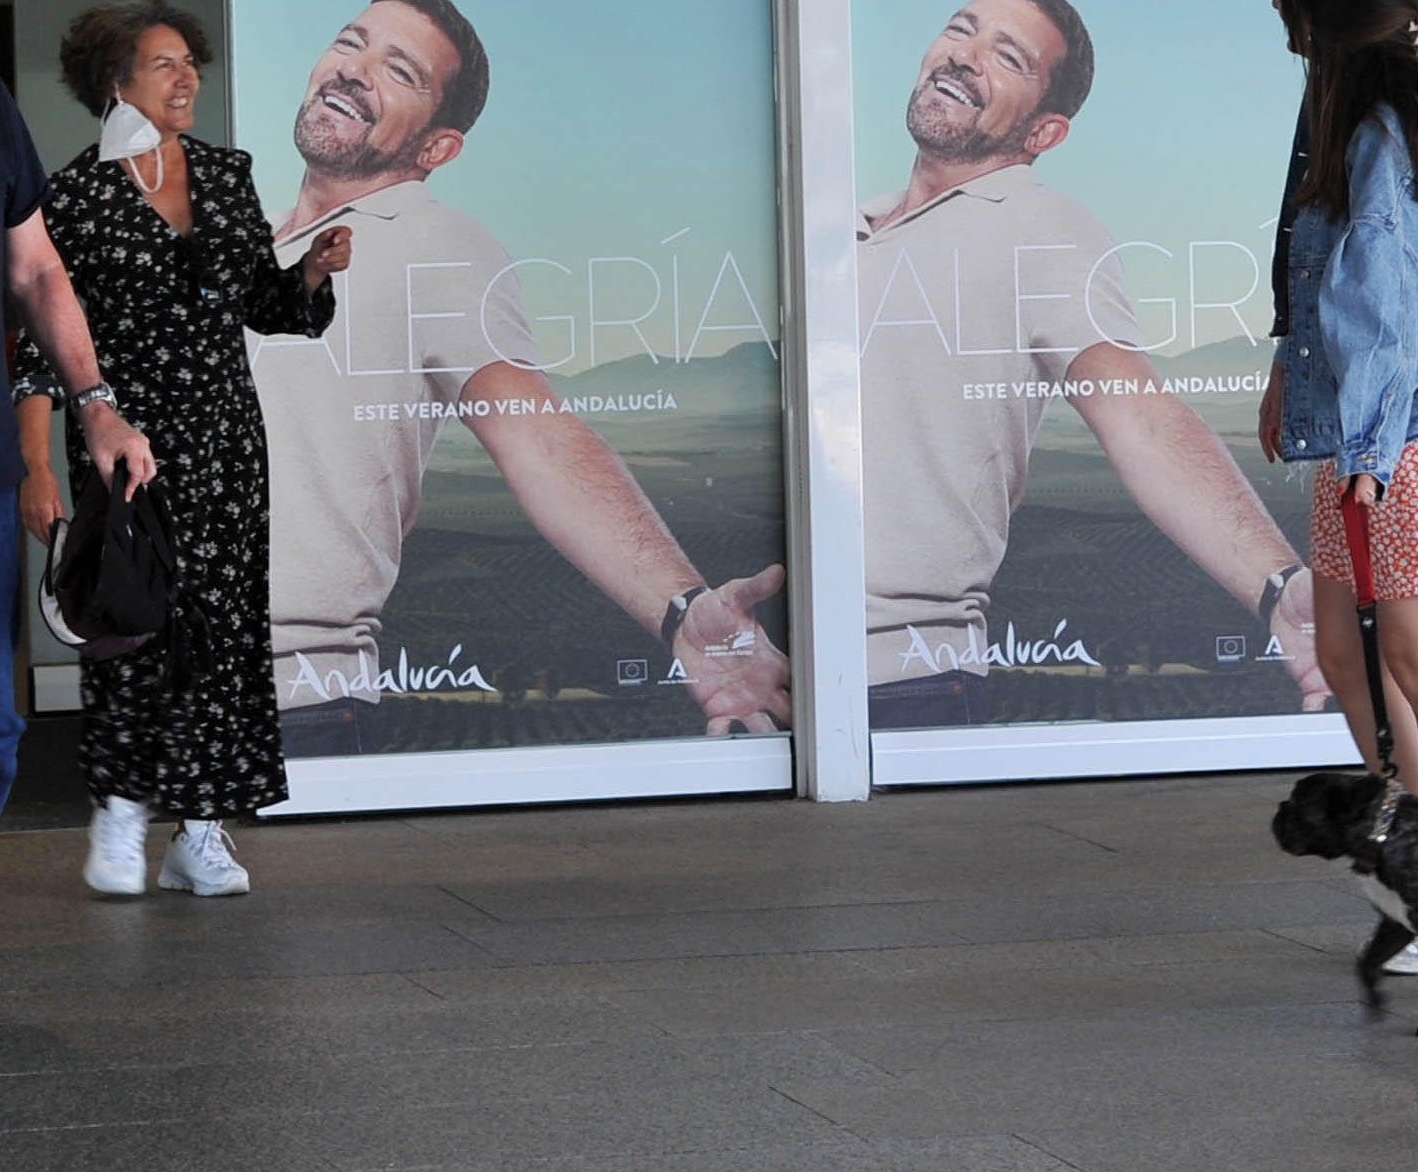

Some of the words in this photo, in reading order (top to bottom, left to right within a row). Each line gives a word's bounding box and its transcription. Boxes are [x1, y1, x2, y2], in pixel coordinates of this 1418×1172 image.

[353, 402, 400, 423] ESTE
[403, 399, 490, 421] VERANO
[494, 397, 536, 417] VEN
[540, 397, 556, 415] A
[559, 388, 678, 415] ANDALUCÍA
[962, 382, 1007, 401] ESTE
[1010, 379, 1095, 399] VERANO
[1099, 378, 1139, 396] VEN
[1143, 377, 1159, 395] A
[897, 618, 1102, 673] Andalucía
[287, 643, 498, 700] Andalucía
